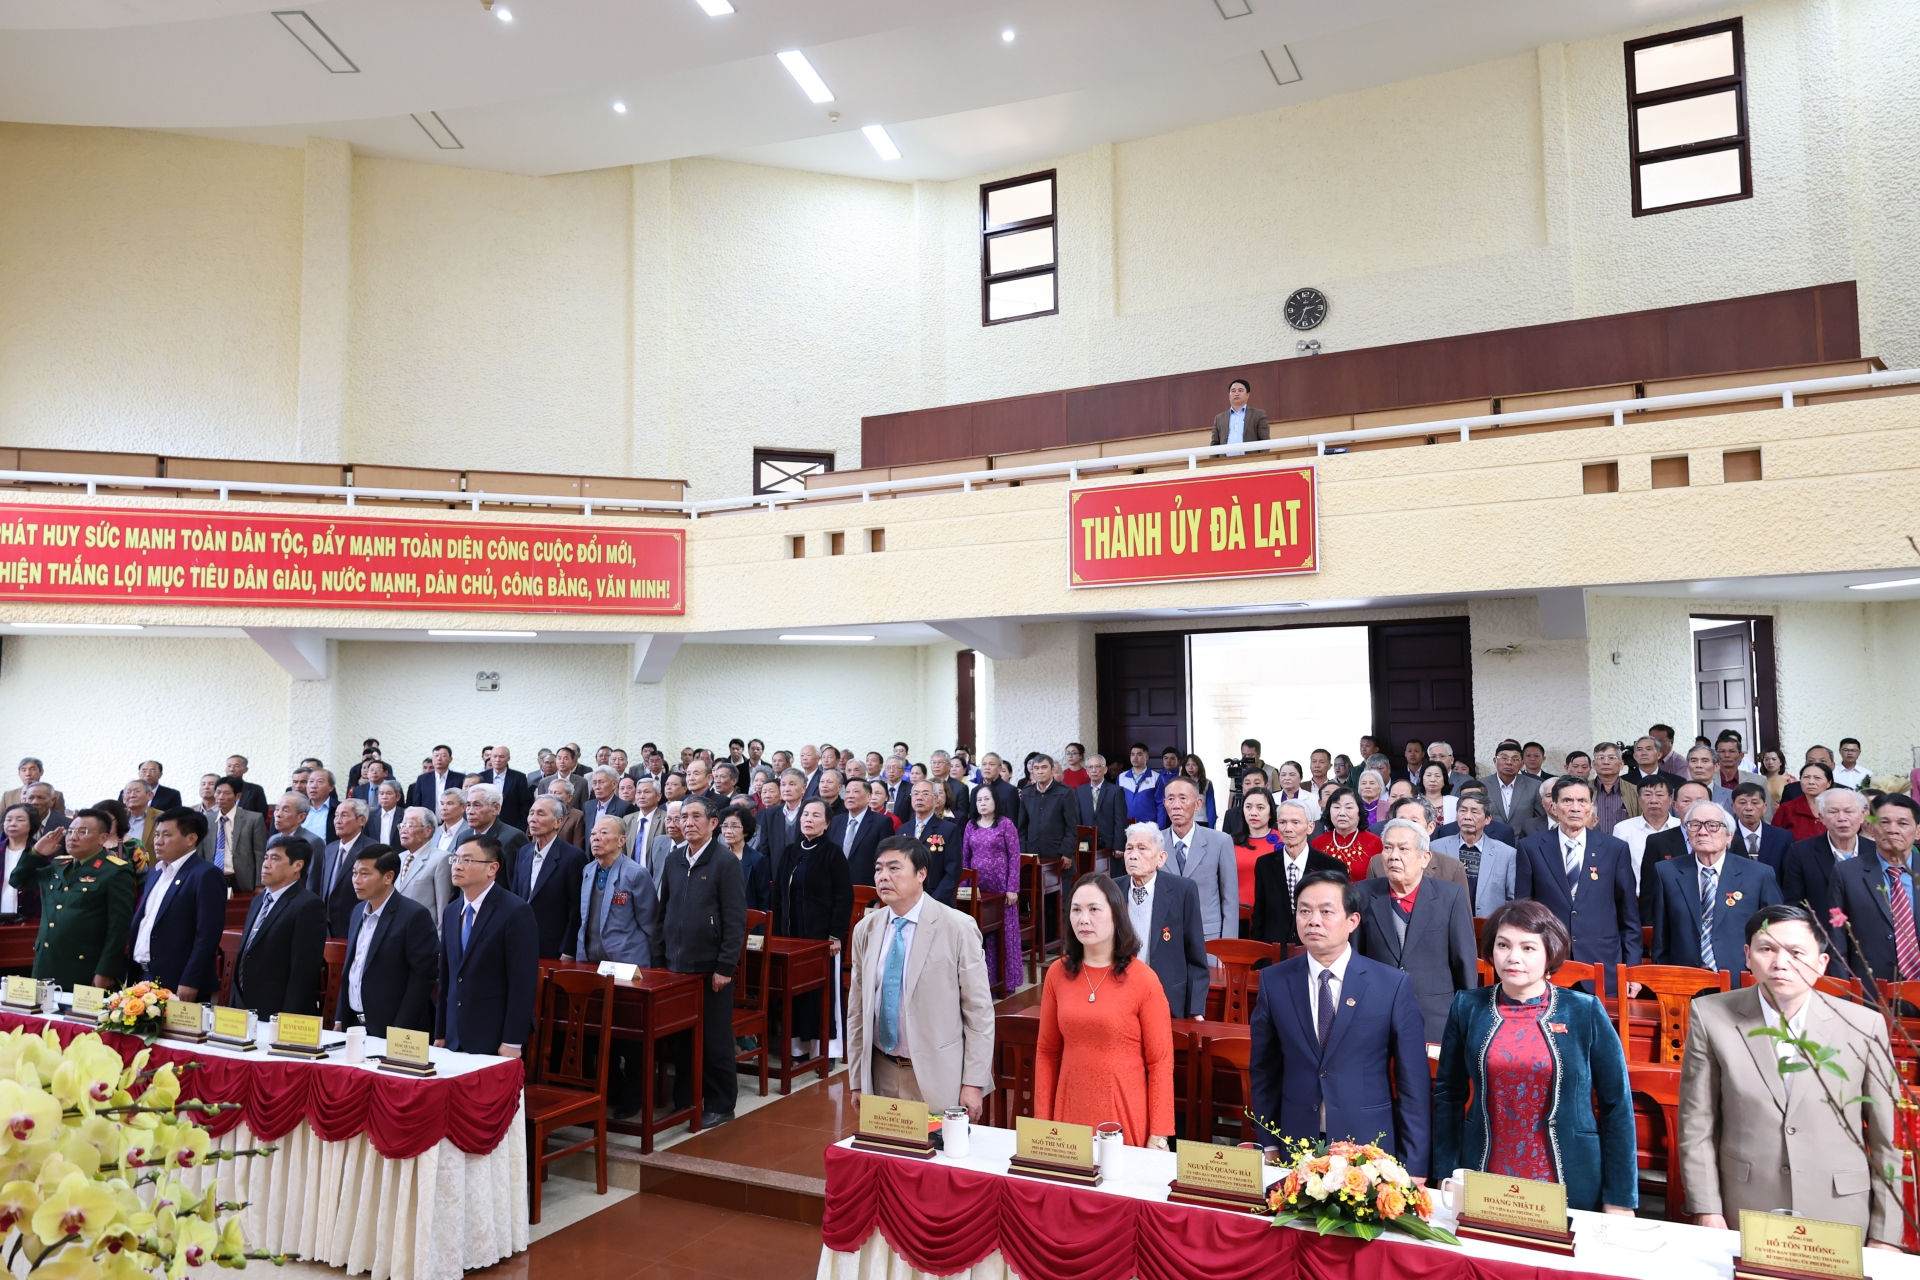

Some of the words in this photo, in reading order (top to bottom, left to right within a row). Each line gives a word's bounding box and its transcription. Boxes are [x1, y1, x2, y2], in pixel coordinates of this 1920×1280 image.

[0, 517, 38, 545] HÁT
[43, 524, 80, 547] HUY
[85, 520, 120, 548] SỨC
[125, 527, 176, 555] MẠNH
[181, 524, 227, 551] TOÀN
[232, 527, 266, 552] DÂN
[271, 528, 308, 559] TỘC,
[312, 524, 345, 555] ĐẨY
[350, 535, 396, 562] MẠNH
[401, 532, 442, 558] TOÀN
[448, 535, 483, 565] DIỆN
[487, 536, 529, 561] CÔNG
[533, 538, 573, 567] CUỘC
[577, 534, 601, 563] ĐỔI
[606, 540, 636, 568] MỚI,
[1081, 505, 1161, 561] THÀNH
[1170, 495, 1202, 554] ỦY
[1210, 496, 1246, 552] ĐÀ
[1253, 499, 1301, 557] LẠT
[0, 556, 42, 590] HIỆN
[48, 554, 108, 586] THẮNG
[114, 561, 142, 592] LỢI
[147, 566, 185, 593] MỤC
[190, 563, 229, 589] TIÊU
[233, 564, 268, 590] DÂN
[273, 564, 317, 595] GIÀU,
[322, 566, 366, 592] NƯỚC
[371, 572, 421, 598] MẠNH,
[425, 569, 457, 594] DÂN
[462, 568, 497, 599] CHỦ,
[501, 572, 543, 596] CÔNG
[548, 569, 592, 601] BẰNG,
[596, 574, 625, 598] VĂN
[630, 579, 670, 599] MINH!
[1187, 1162, 1214, 1171] NGUYỄN
